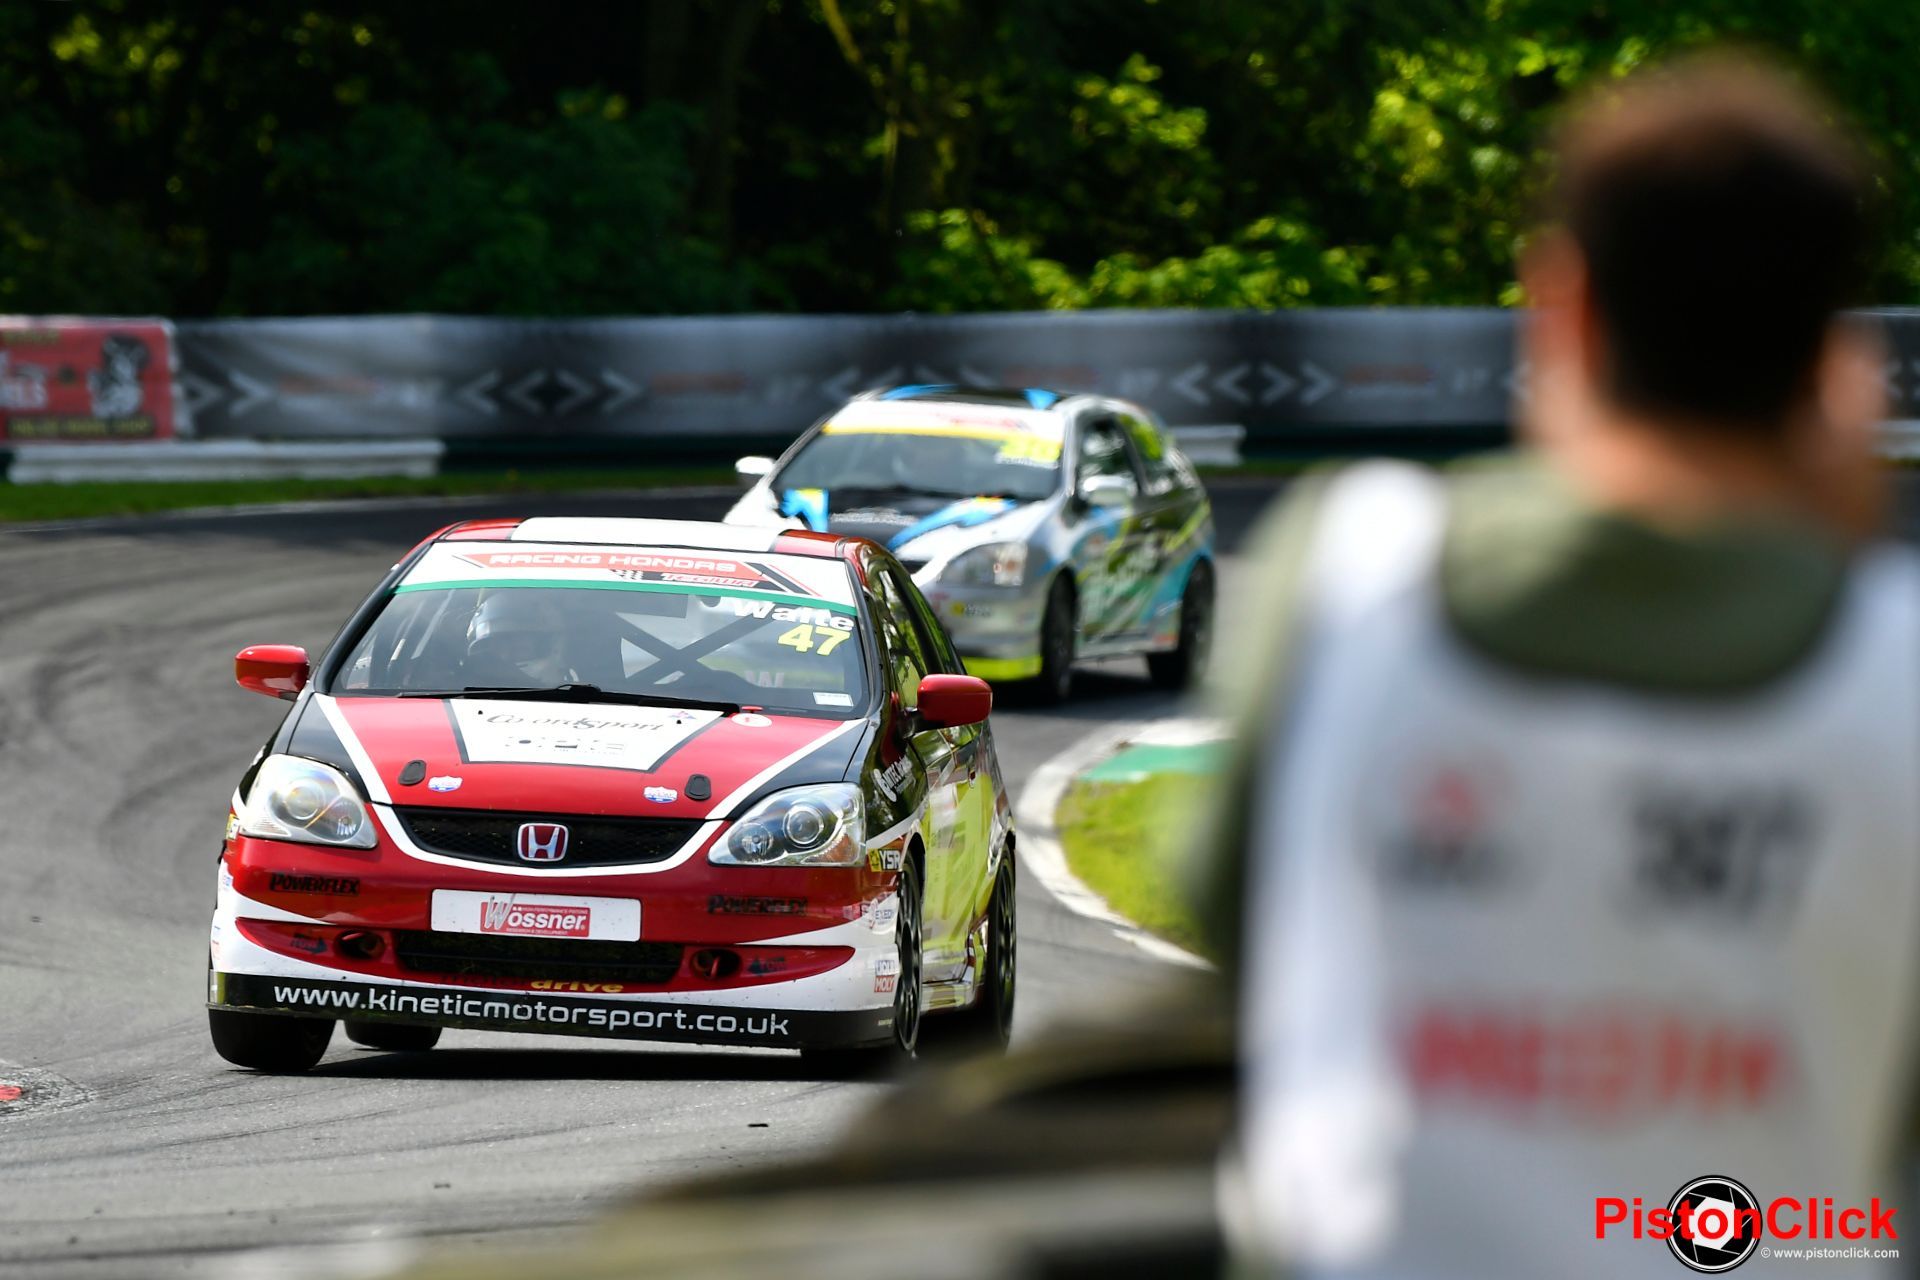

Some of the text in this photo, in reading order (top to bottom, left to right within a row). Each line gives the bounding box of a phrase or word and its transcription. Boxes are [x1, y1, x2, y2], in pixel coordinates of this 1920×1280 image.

[489, 553, 737, 572] RACING HONDAS
[778, 624, 850, 656] 47
[270, 872, 360, 894] POWERFLEX
[484, 893, 587, 931] Wössner
[530, 980, 624, 993] drive
[273, 986, 789, 1035] www.kineticmotorsport.co.uk
